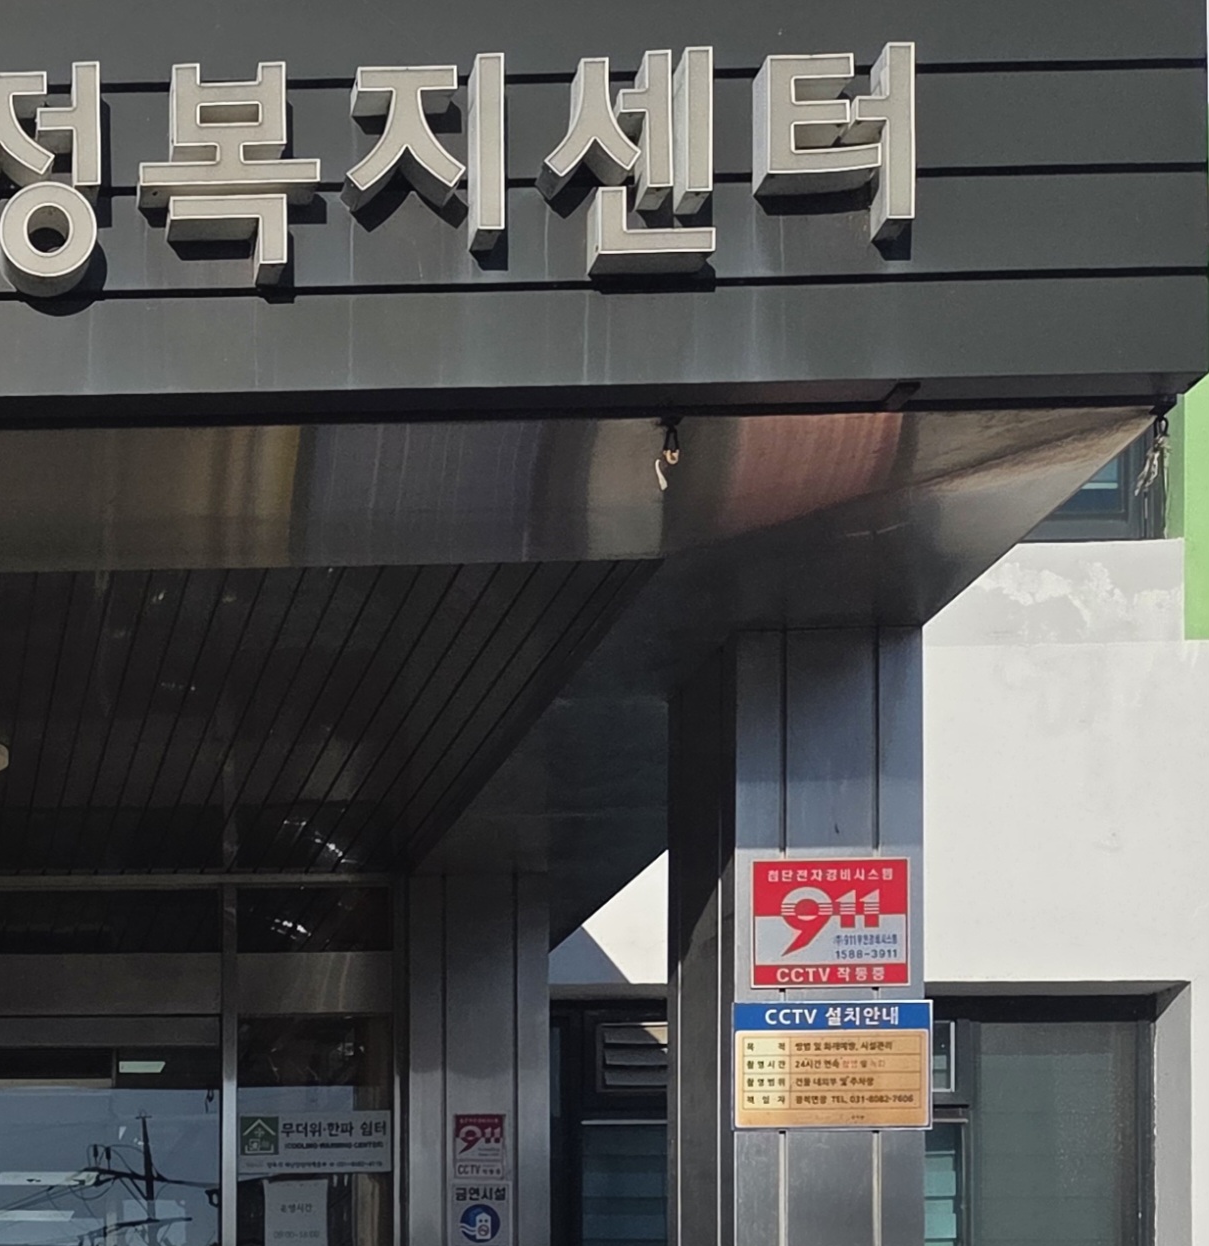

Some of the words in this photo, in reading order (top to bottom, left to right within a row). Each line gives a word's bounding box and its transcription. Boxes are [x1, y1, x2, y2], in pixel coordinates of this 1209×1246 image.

[767, 868, 893, 882] 첨단전자경비시스템
[781, 886, 880, 957] 911
[835, 949, 898, 959] 1588-3911
[776, 966, 830, 982] CCTV
[837, 966, 885, 981] 작동중
[765, 1009, 818, 1024] CCTV
[825, 1006, 900, 1025] 설치안내
[795, 1059, 821, 1069] 24시간
[795, 1077, 811, 1087] 건물
[359, 1121, 387, 1137] 쉼터
[459, 1125, 501, 1155] 911
[457, 1164, 481, 1175] CCTV
[454, 1187, 506, 1202] 금연시설
